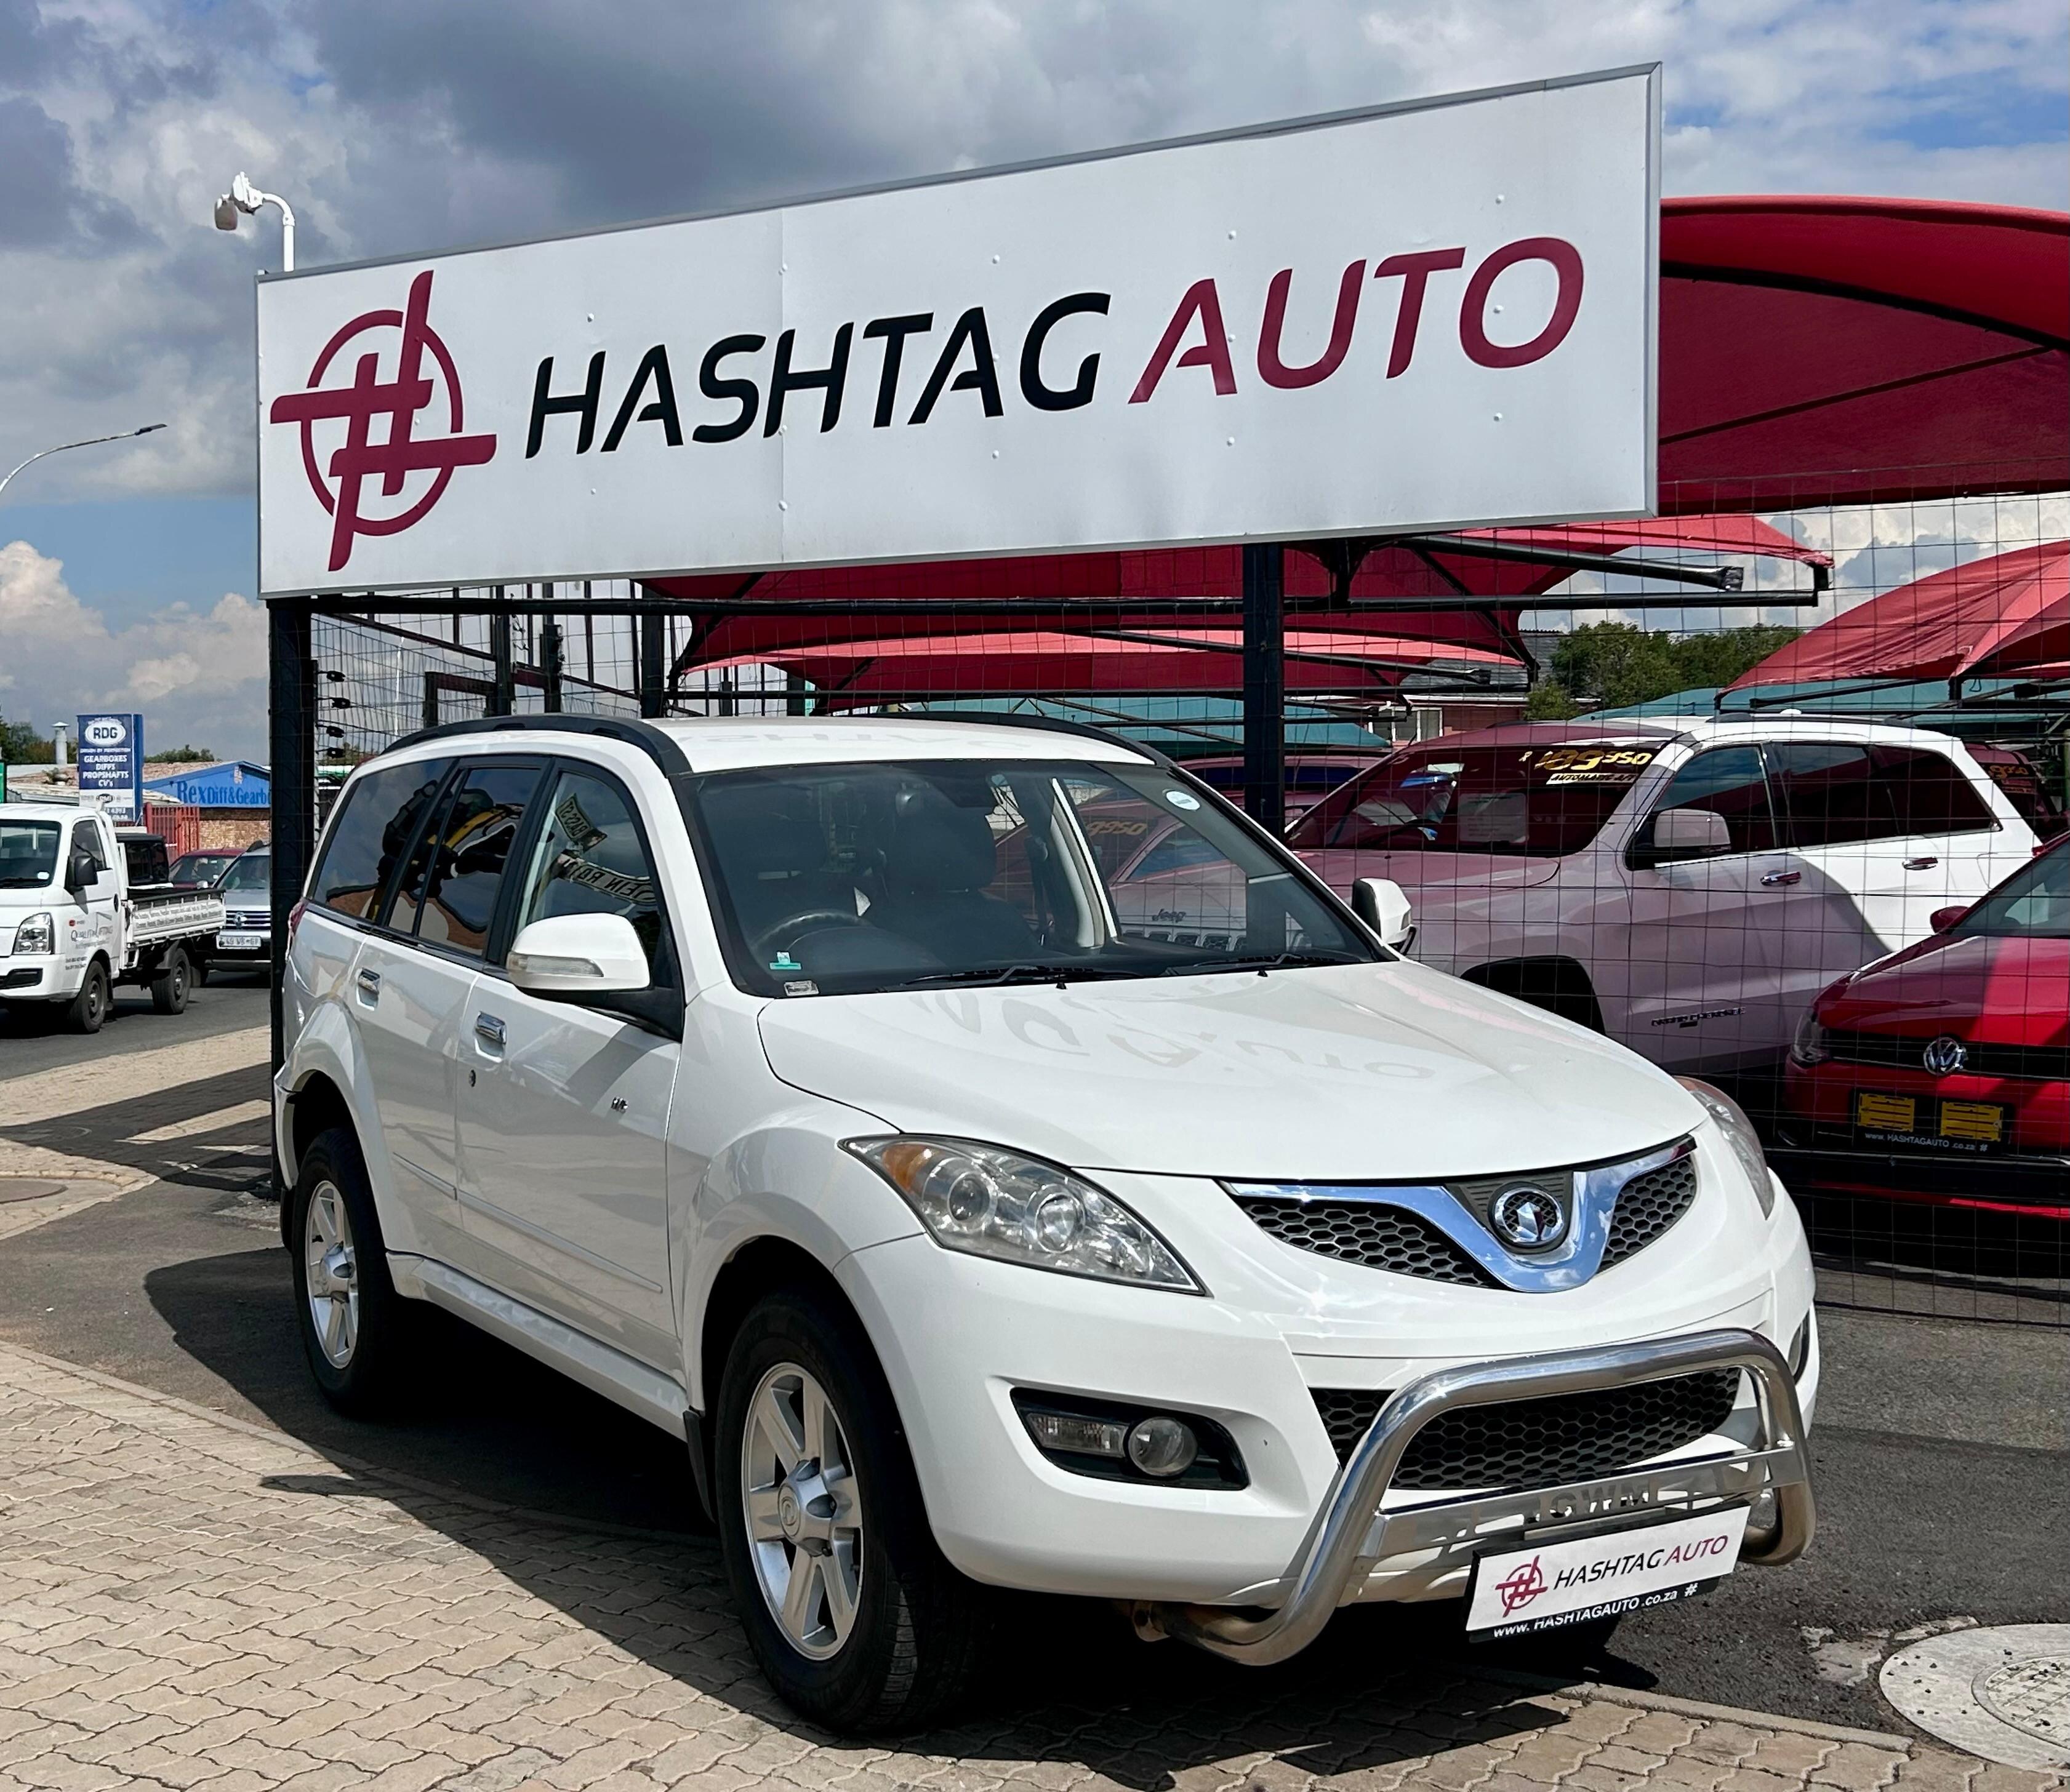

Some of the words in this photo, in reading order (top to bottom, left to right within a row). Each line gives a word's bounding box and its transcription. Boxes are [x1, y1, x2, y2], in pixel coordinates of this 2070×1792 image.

[525, 292, 1112, 459] HASHTAG
[1128, 236, 1584, 404] AUTO
[93, 727, 118, 739] RDG
[82, 770, 129, 778] PROPSHAFTS
[1887, 1133, 1950, 1148] HASHTAGAUTO
[1553, 1549, 1665, 1590] HASHTAG
[1663, 1534, 1729, 1566] AUTO
[1533, 1597, 1640, 1631] HASHTAGAUTO
